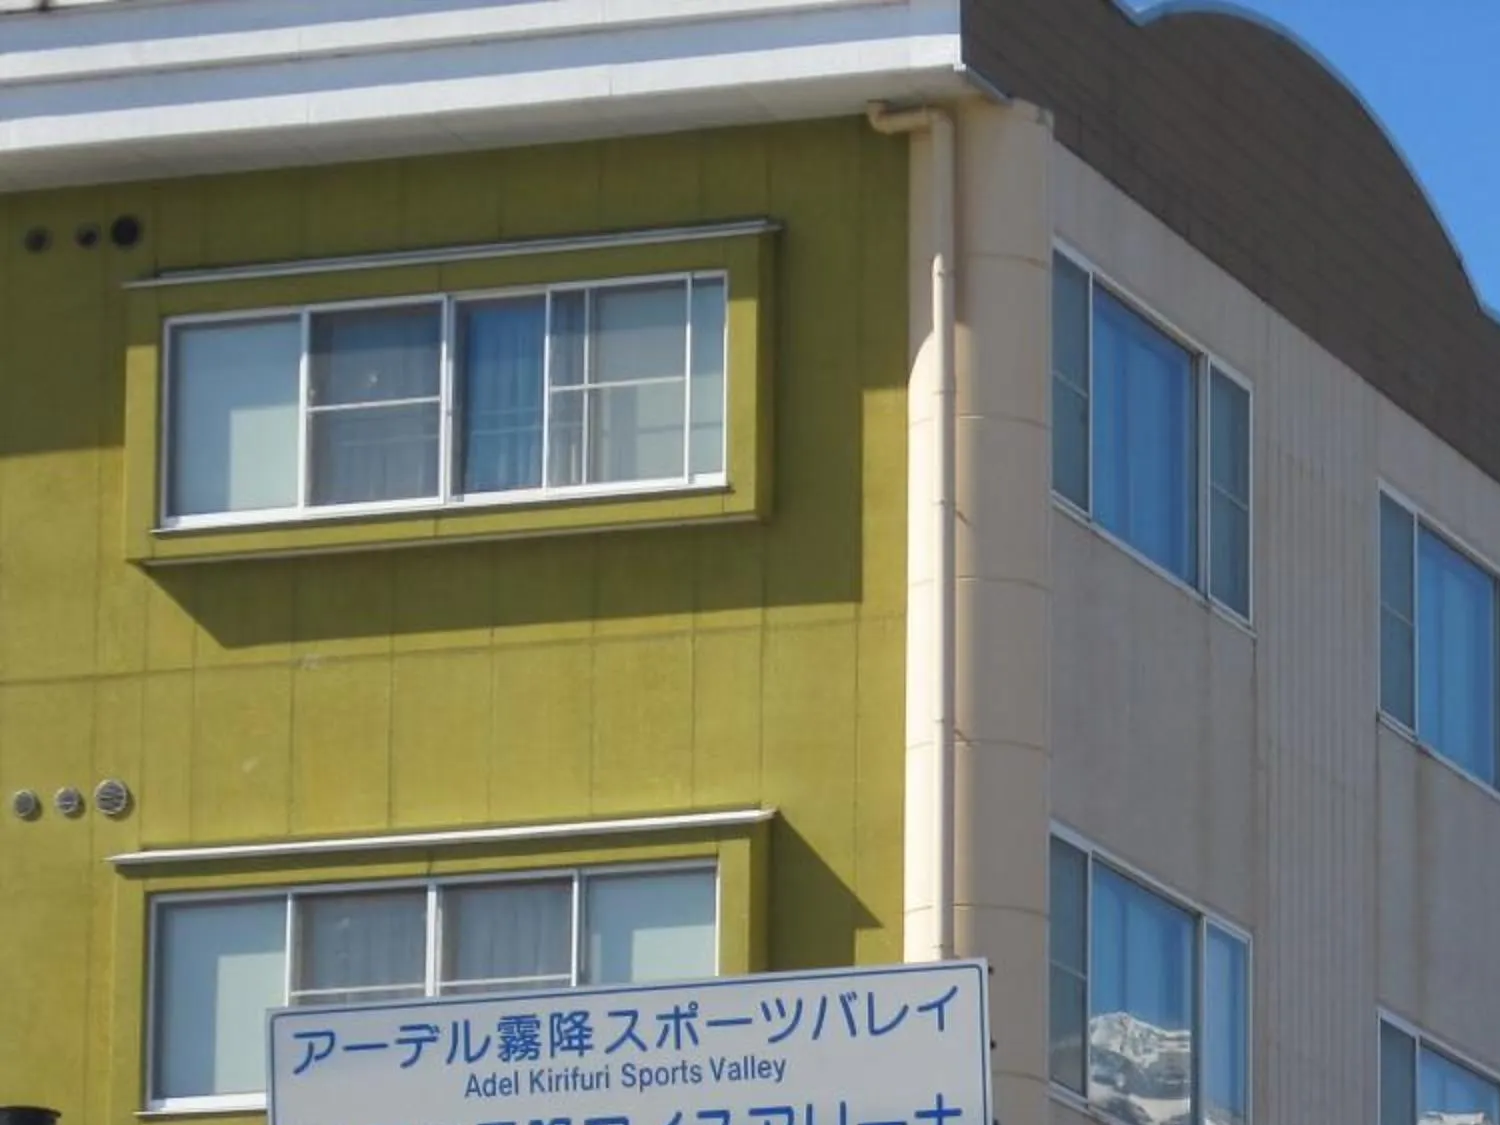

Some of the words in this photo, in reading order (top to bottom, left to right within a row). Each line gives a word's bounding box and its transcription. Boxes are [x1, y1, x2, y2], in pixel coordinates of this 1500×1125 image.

[291, 986, 960, 1076] アーデル霧降スポーツバレイ
[465, 1070, 520, 1099] Adel
[528, 1064, 611, 1094] Kirifuri
[620, 1057, 702, 1094] Sports
[710, 1055, 787, 1085] Valley
